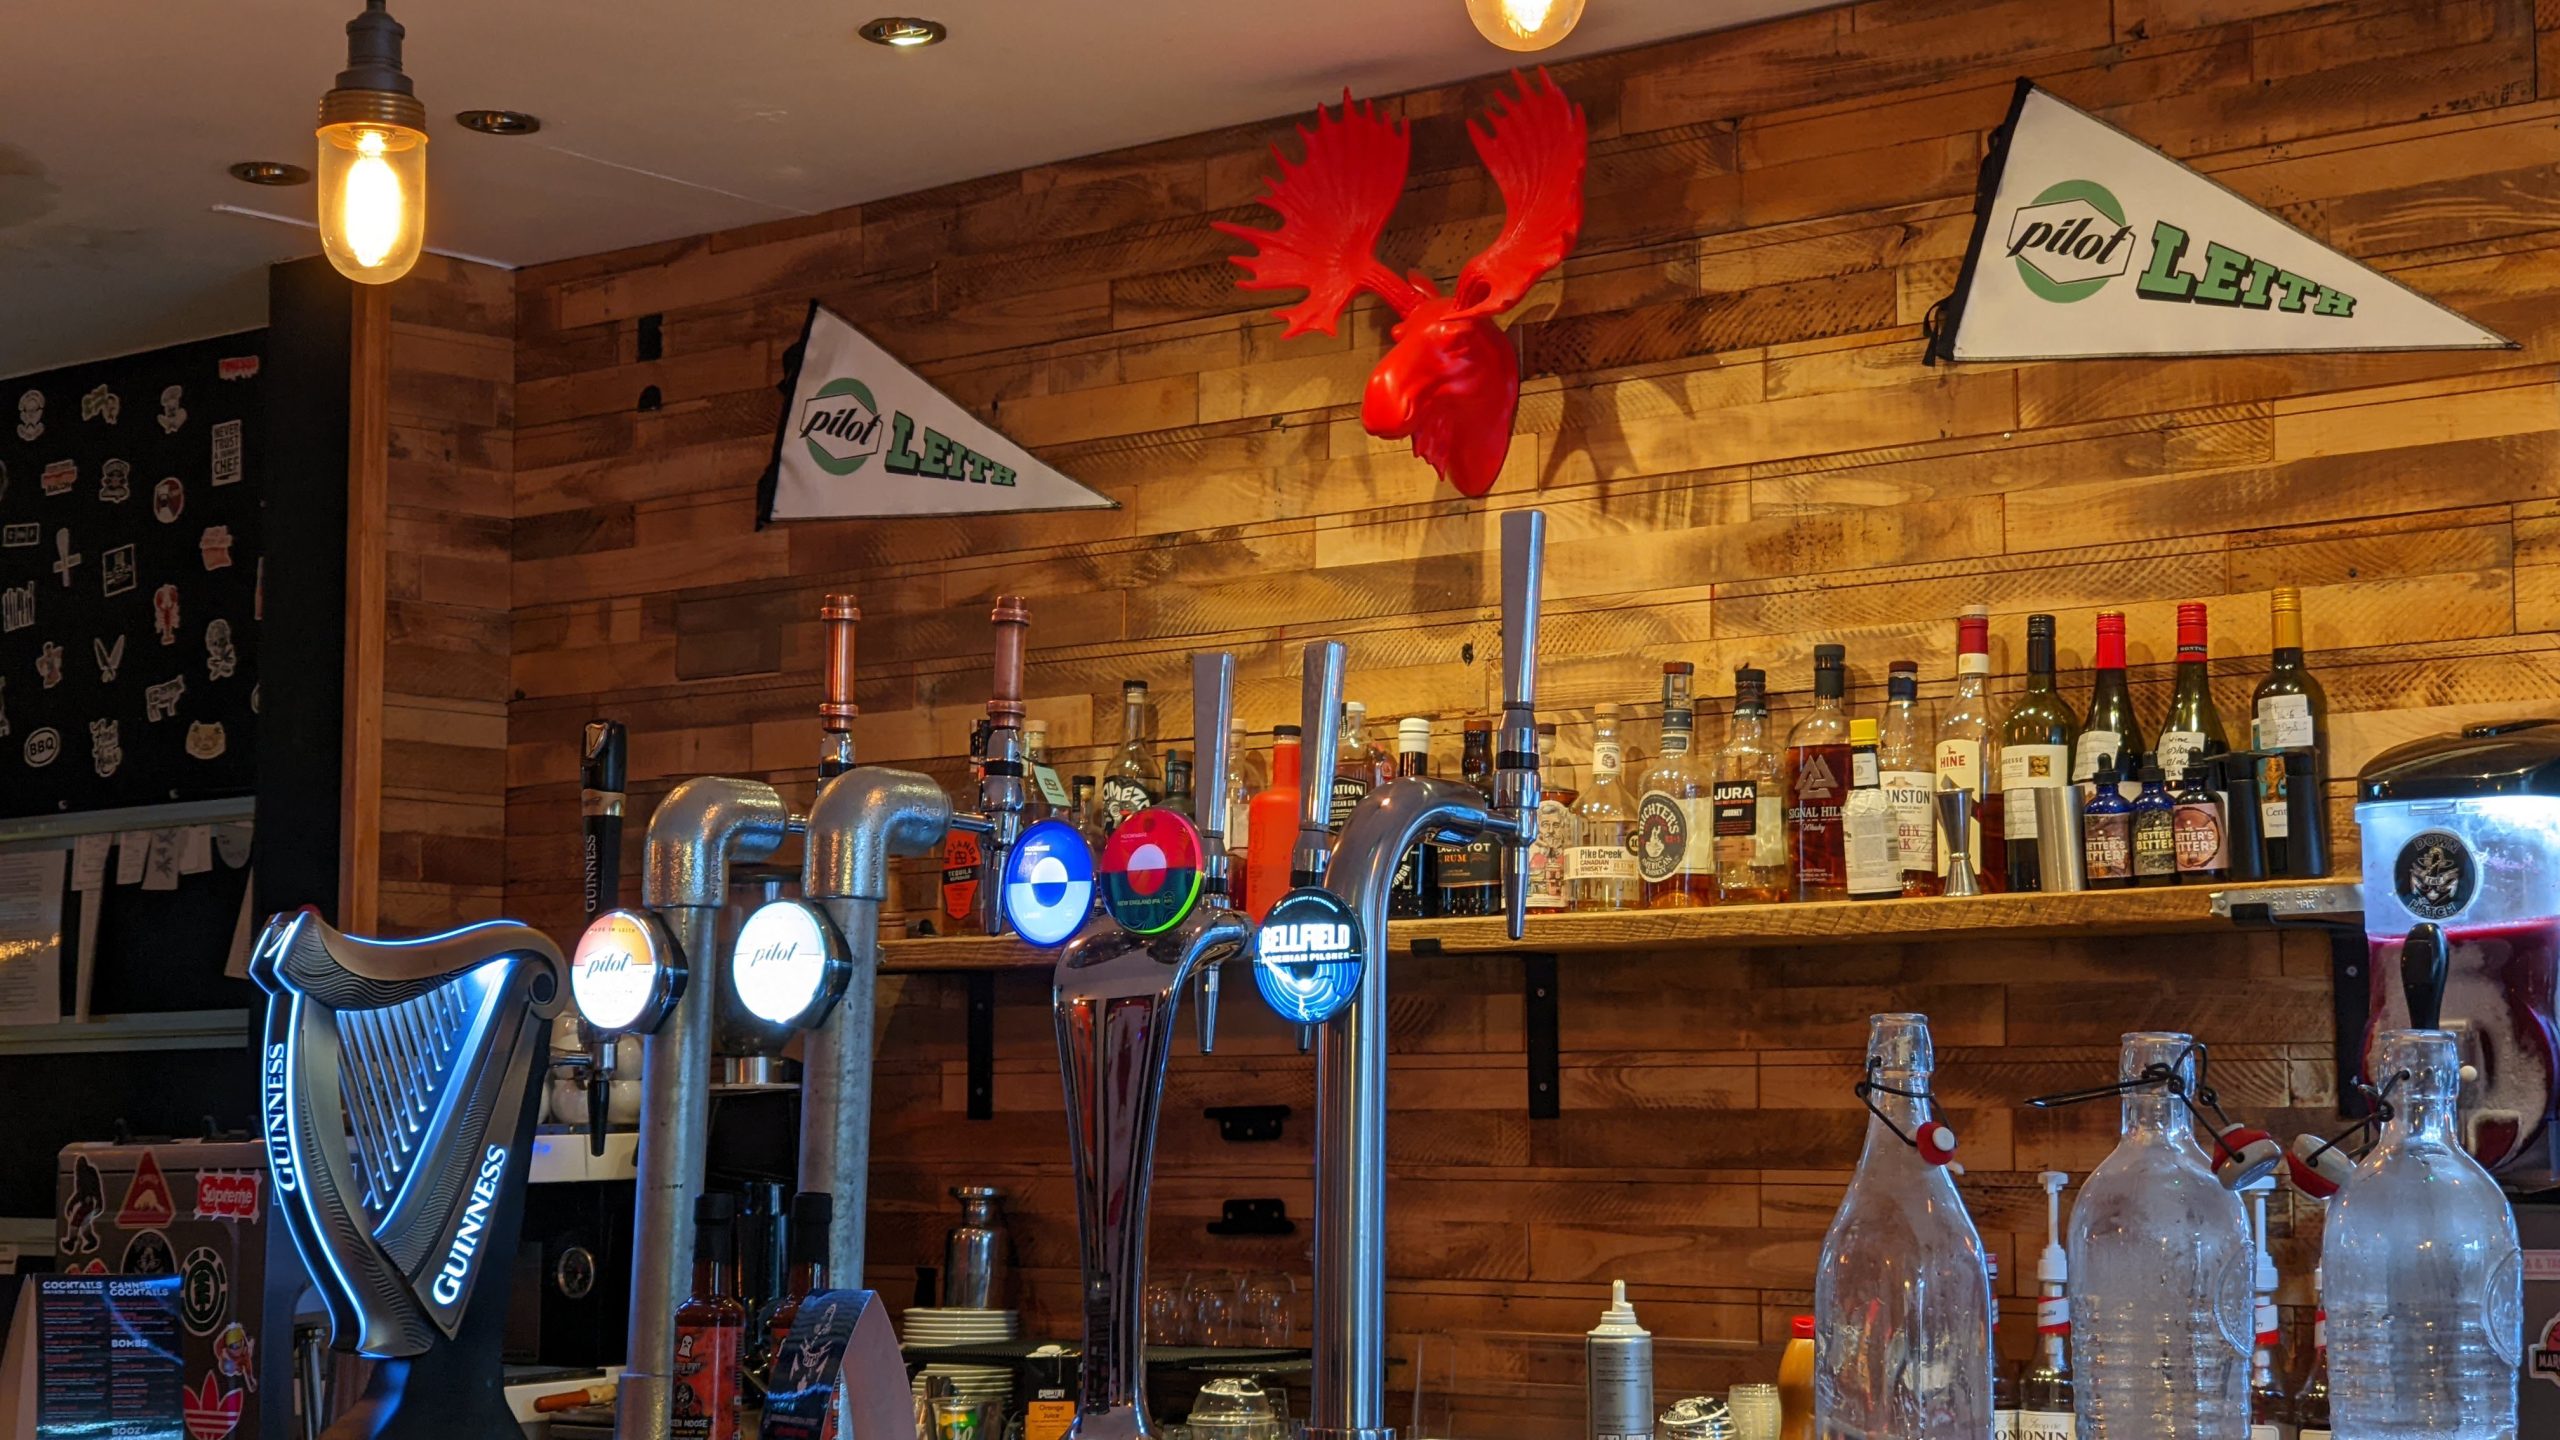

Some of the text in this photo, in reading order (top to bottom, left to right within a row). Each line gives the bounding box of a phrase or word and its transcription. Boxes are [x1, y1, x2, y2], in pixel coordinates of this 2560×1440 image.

[2005, 217, 2134, 265] pilot
[2136, 220, 2357, 318] LEITH
[214, 424, 239, 437] NEVER
[799, 407, 881, 446] pilot
[214, 435, 239, 449] TRUST
[884, 410, 1017, 487] LEITH
[214, 456, 240, 475] CHEF
[30, 737, 54, 756] BBQ
[1940, 755, 1966, 769] HINE
[1714, 786, 1754, 801] JURA
[1639, 802, 1680, 835] MICHTER'S
[1788, 807, 1819, 819] SIGNAL
[2175, 831, 2214, 841] ETTER'S
[2175, 841, 2217, 853] ITTERS
[2414, 835, 2460, 854] DOWN
[1444, 854, 1467, 863] RUM
[1580, 849, 1622, 859] Pike Creek
[1641, 855, 1673, 870] AMERICAN
[585, 834, 597, 913] GUINNESS
[948, 868, 972, 877] TEQUILA
[2248, 889, 2326, 900] SUPPORT EVERY
[2408, 899, 2457, 918] HATCH
[1262, 924, 1350, 953] BELLFIELD
[750, 941, 799, 967] pilot
[1309, 952, 1350, 961] PILSNER
[586, 951, 631, 979] pilot
[267, 1042, 297, 1192] GUINNESS
[202, 1183, 253, 1206] Supreme
[432, 1144, 507, 1306] GUINNESS
[42, 1281, 103, 1290] COCKTAILS
[109, 1281, 153, 1289] CANNED
[109, 1288, 169, 1297] COCKTAILS
[111, 1339, 149, 1348] BOMBS
[2538, 1353, 2560, 1369] MAR
[111, 1426, 149, 1436] BOOZY
